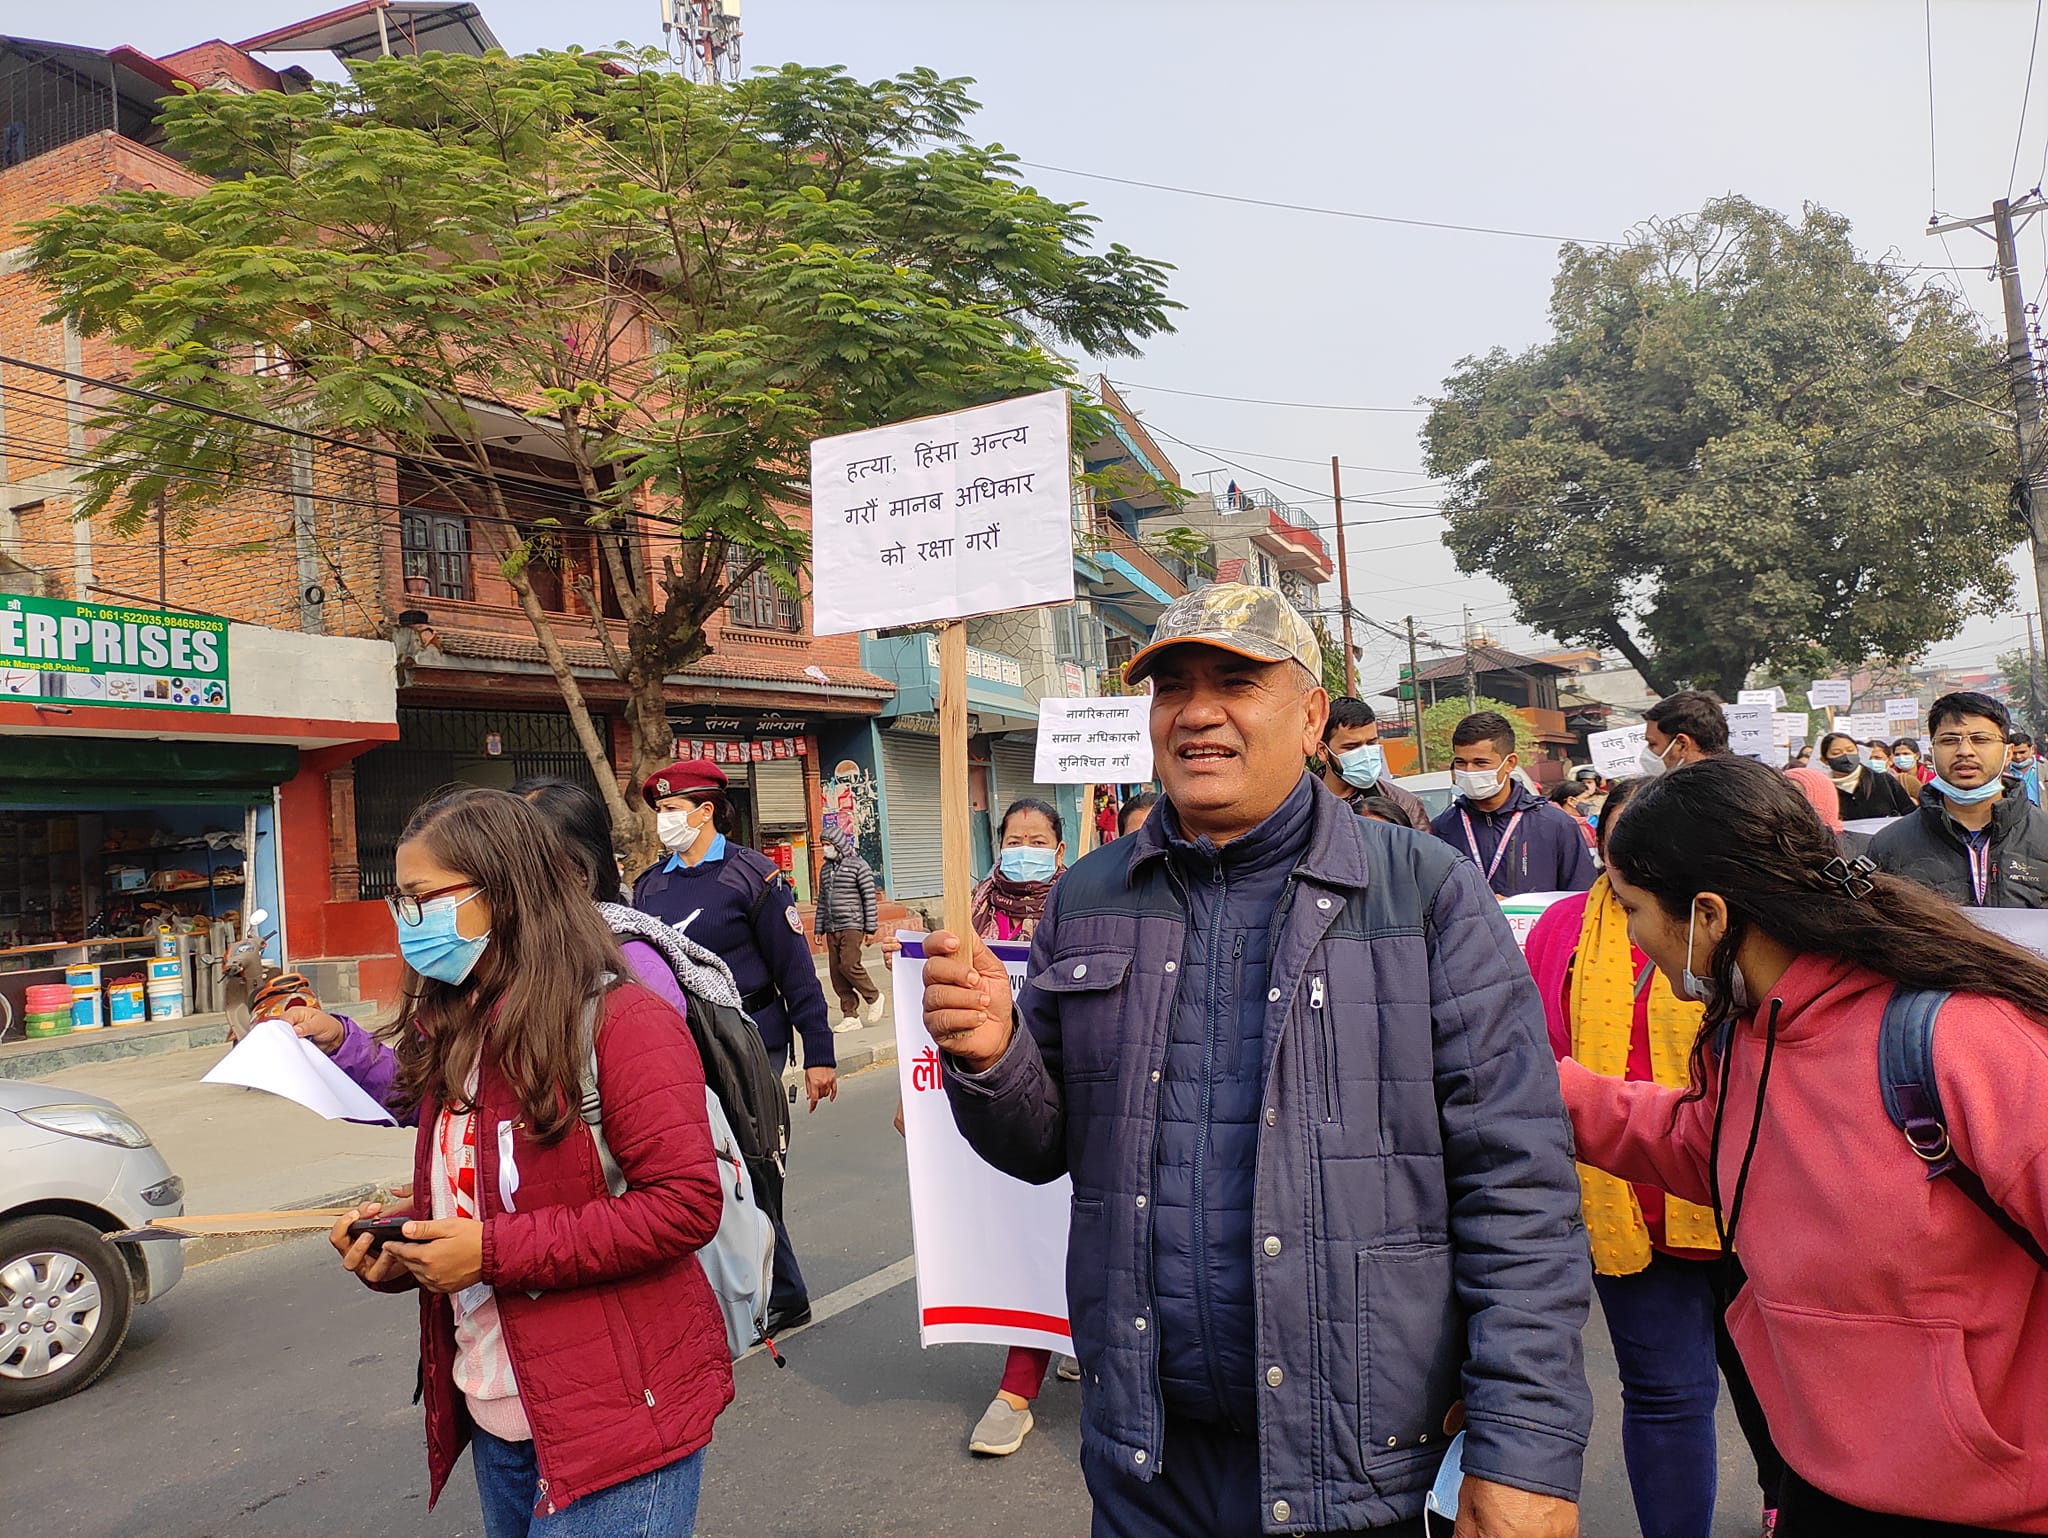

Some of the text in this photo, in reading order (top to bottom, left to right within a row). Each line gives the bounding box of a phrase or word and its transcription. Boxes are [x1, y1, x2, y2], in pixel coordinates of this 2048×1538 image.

[914, 440, 959, 468] हिंसा
[970, 426, 1029, 456] अन्त्य
[844, 473, 1035, 525] गरौं मानब अधिकार
[880, 522, 1000, 566] को रक्षा गरौं
[76, 606, 223, 632] Ph: 061-522035,9846585263
[1066, 707, 1129, 719] नागरिकतामा
[1052, 730, 1141, 743] समान अधिकारको
[1058, 754, 1131, 772] सुनिश्चित गरौं
